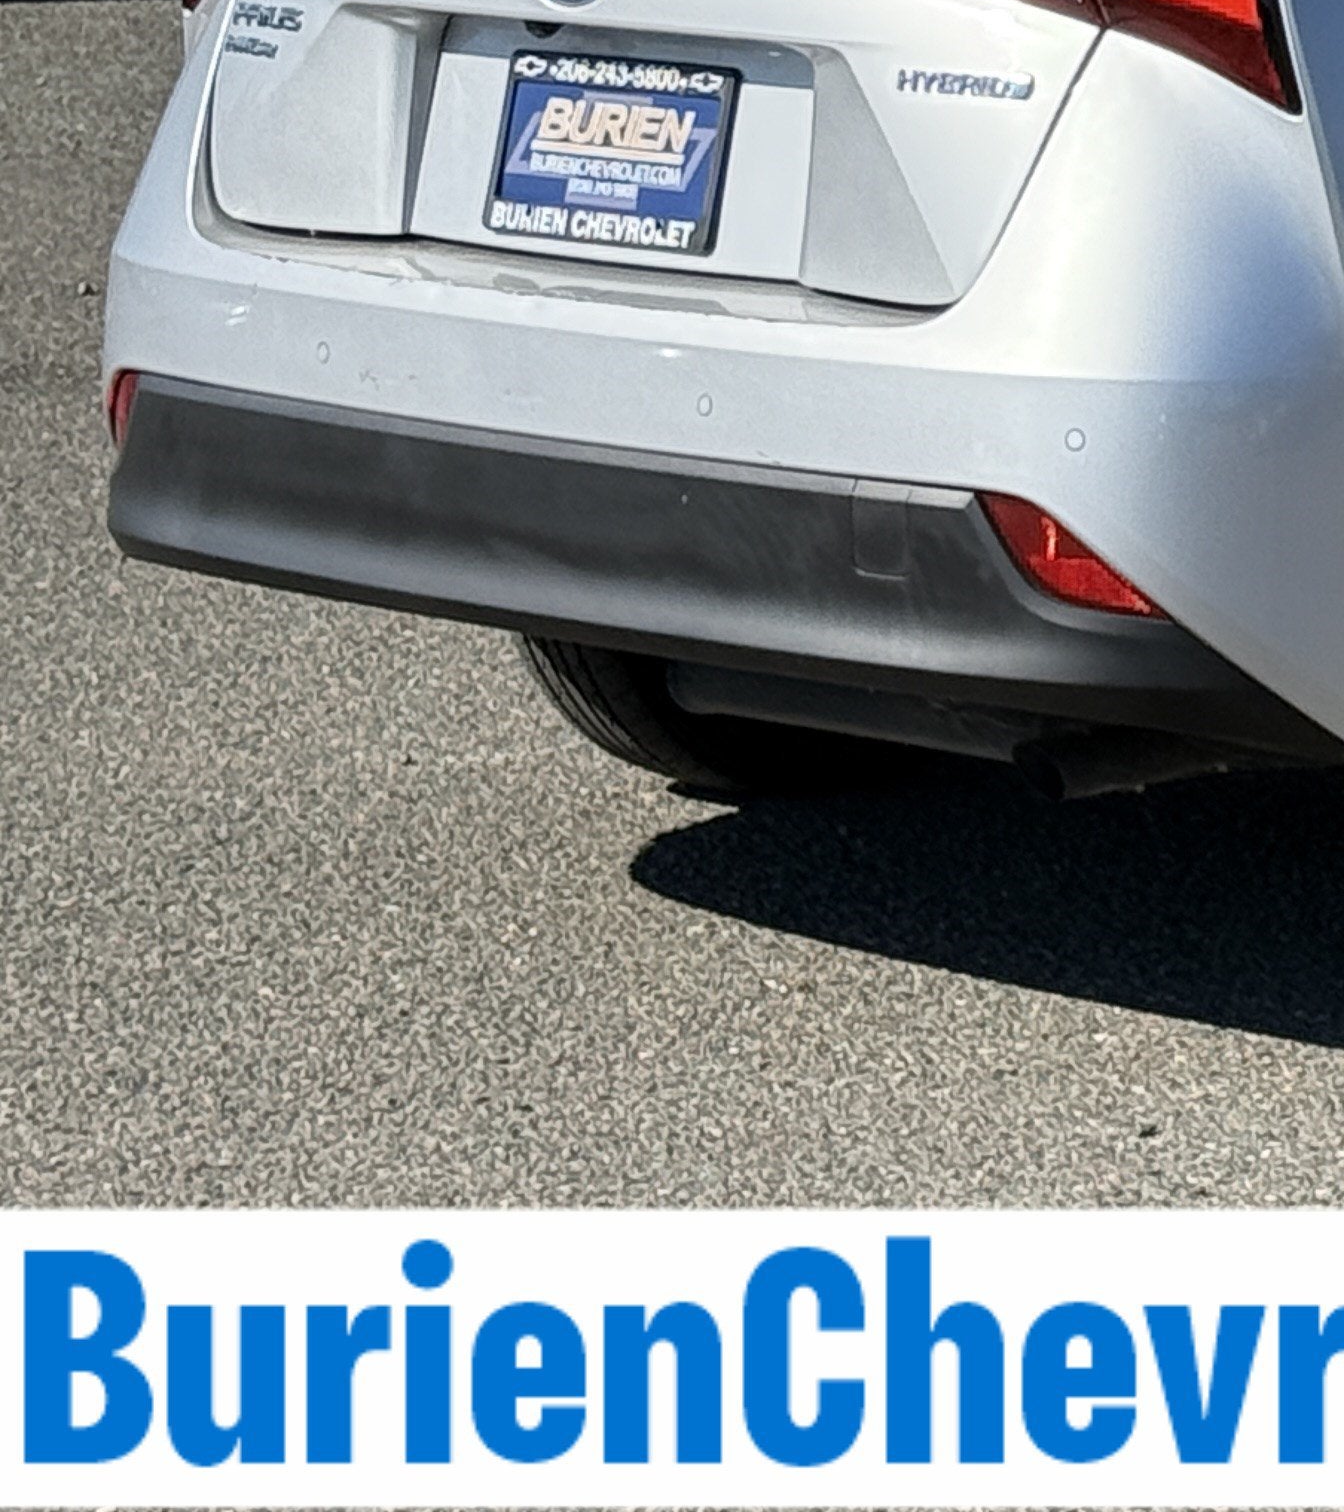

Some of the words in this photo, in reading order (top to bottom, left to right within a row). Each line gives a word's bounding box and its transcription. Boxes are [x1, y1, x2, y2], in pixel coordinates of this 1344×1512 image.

[537, 96, 697, 153] BURIEN
[490, 200, 569, 236] BURIEN
[570, 209, 697, 249] CHEVROLET
